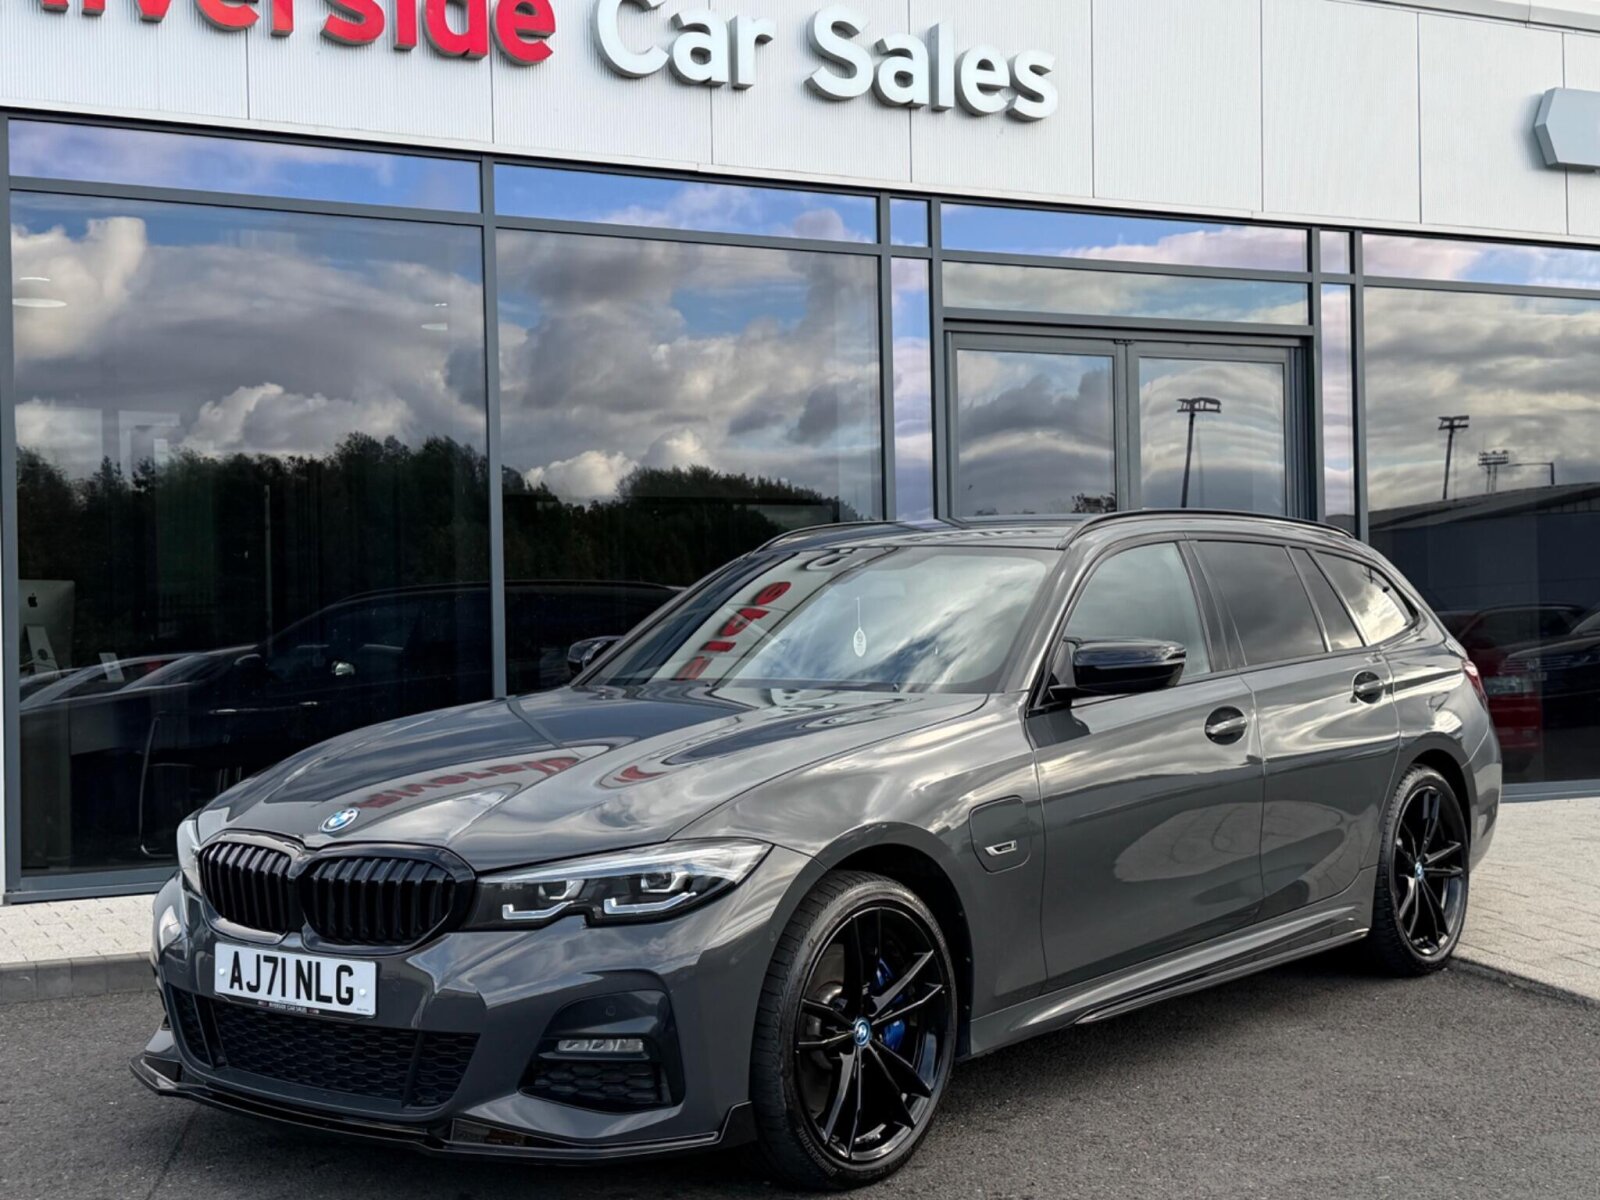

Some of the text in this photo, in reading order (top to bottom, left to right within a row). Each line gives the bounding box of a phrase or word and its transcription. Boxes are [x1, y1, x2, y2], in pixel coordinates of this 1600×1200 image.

[590, 0, 775, 91] Car
[803, 5, 1060, 122] Sales
[229, 950, 354, 1006] AJ71 NLG
